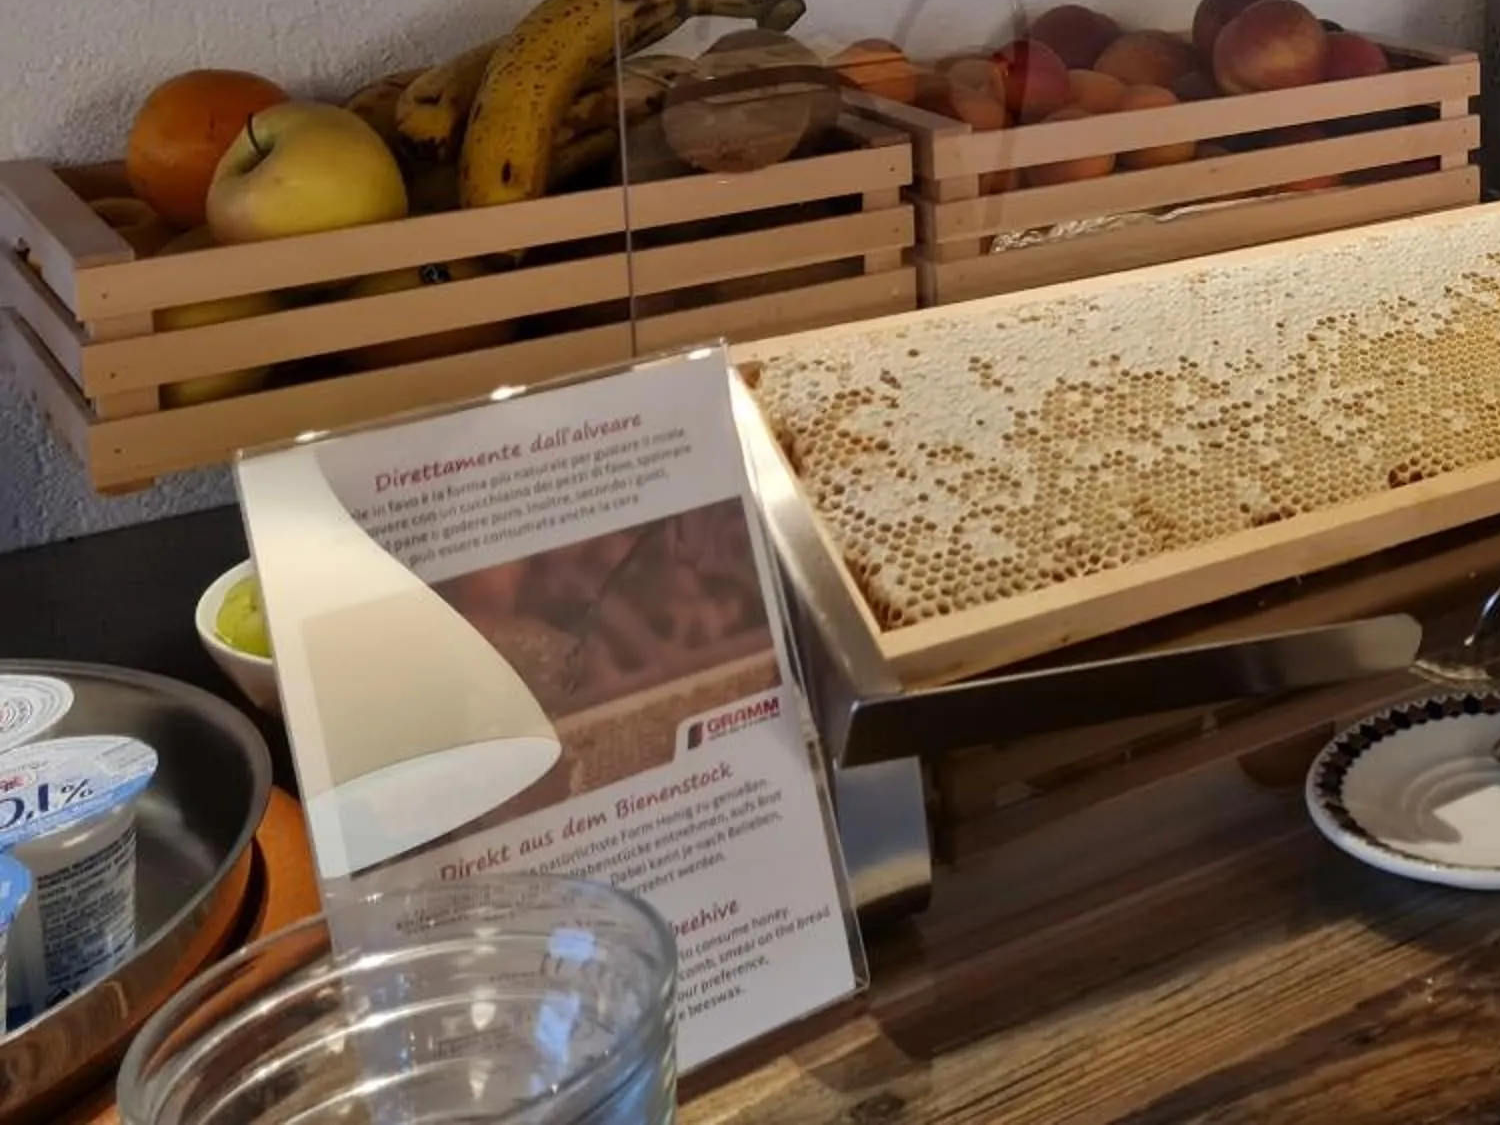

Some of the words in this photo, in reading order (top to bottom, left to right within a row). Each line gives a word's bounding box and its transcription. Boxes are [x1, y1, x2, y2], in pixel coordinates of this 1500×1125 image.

[375, 443, 521, 493] Direttamente
[530, 414, 642, 454] dall'alveare
[388, 496, 419, 513] favo
[447, 478, 487, 498] forma
[411, 511, 437, 527] con
[394, 532, 428, 553] pane
[706, 697, 779, 733] GRAMM
[440, 843, 511, 881] Direkt
[519, 830, 555, 856] aus
[562, 811, 608, 839] dem
[615, 761, 734, 819] Bienenstock
[671, 899, 739, 938] beehive
[719, 939, 755, 964] smear
[758, 931, 773, 947] on
[797, 904, 831, 930] bread
[695, 923, 750, 954] consume
